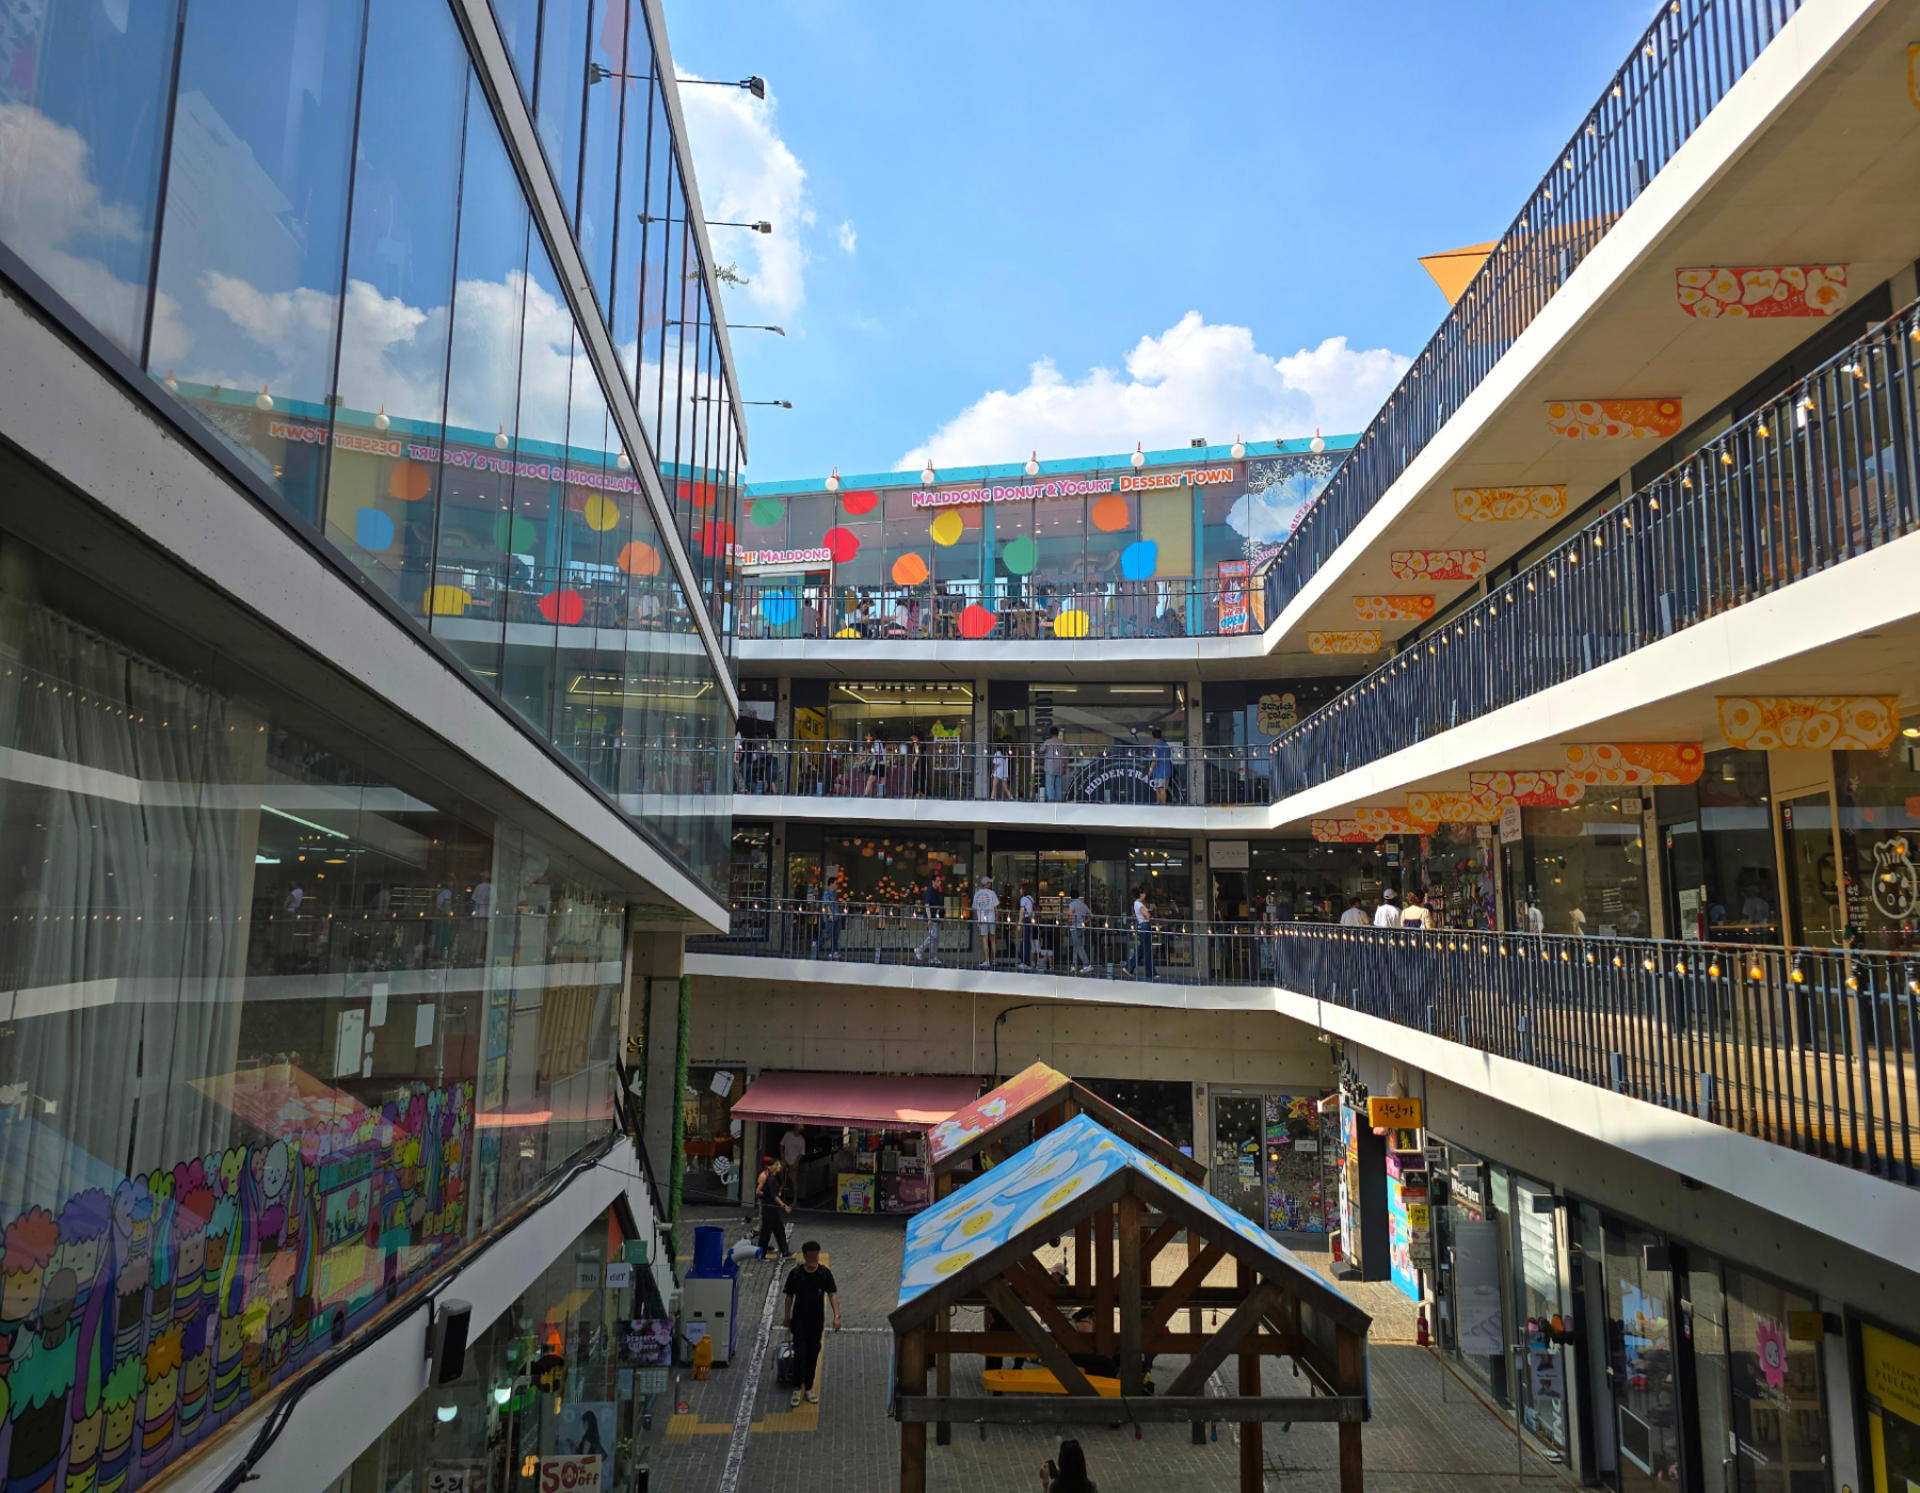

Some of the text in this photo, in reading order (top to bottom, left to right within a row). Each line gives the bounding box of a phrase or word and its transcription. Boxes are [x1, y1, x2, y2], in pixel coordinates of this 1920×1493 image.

[912, 469, 1233, 506] MALDDONG DONUT & YOGURT DESSERT TOWN
[760, 549, 831, 563] MALDDONG
[1219, 613, 1246, 628] OPEN
[1084, 768, 1158, 796] HIDDEN TRAC
[1379, 1103, 1415, 1119] 식당가
